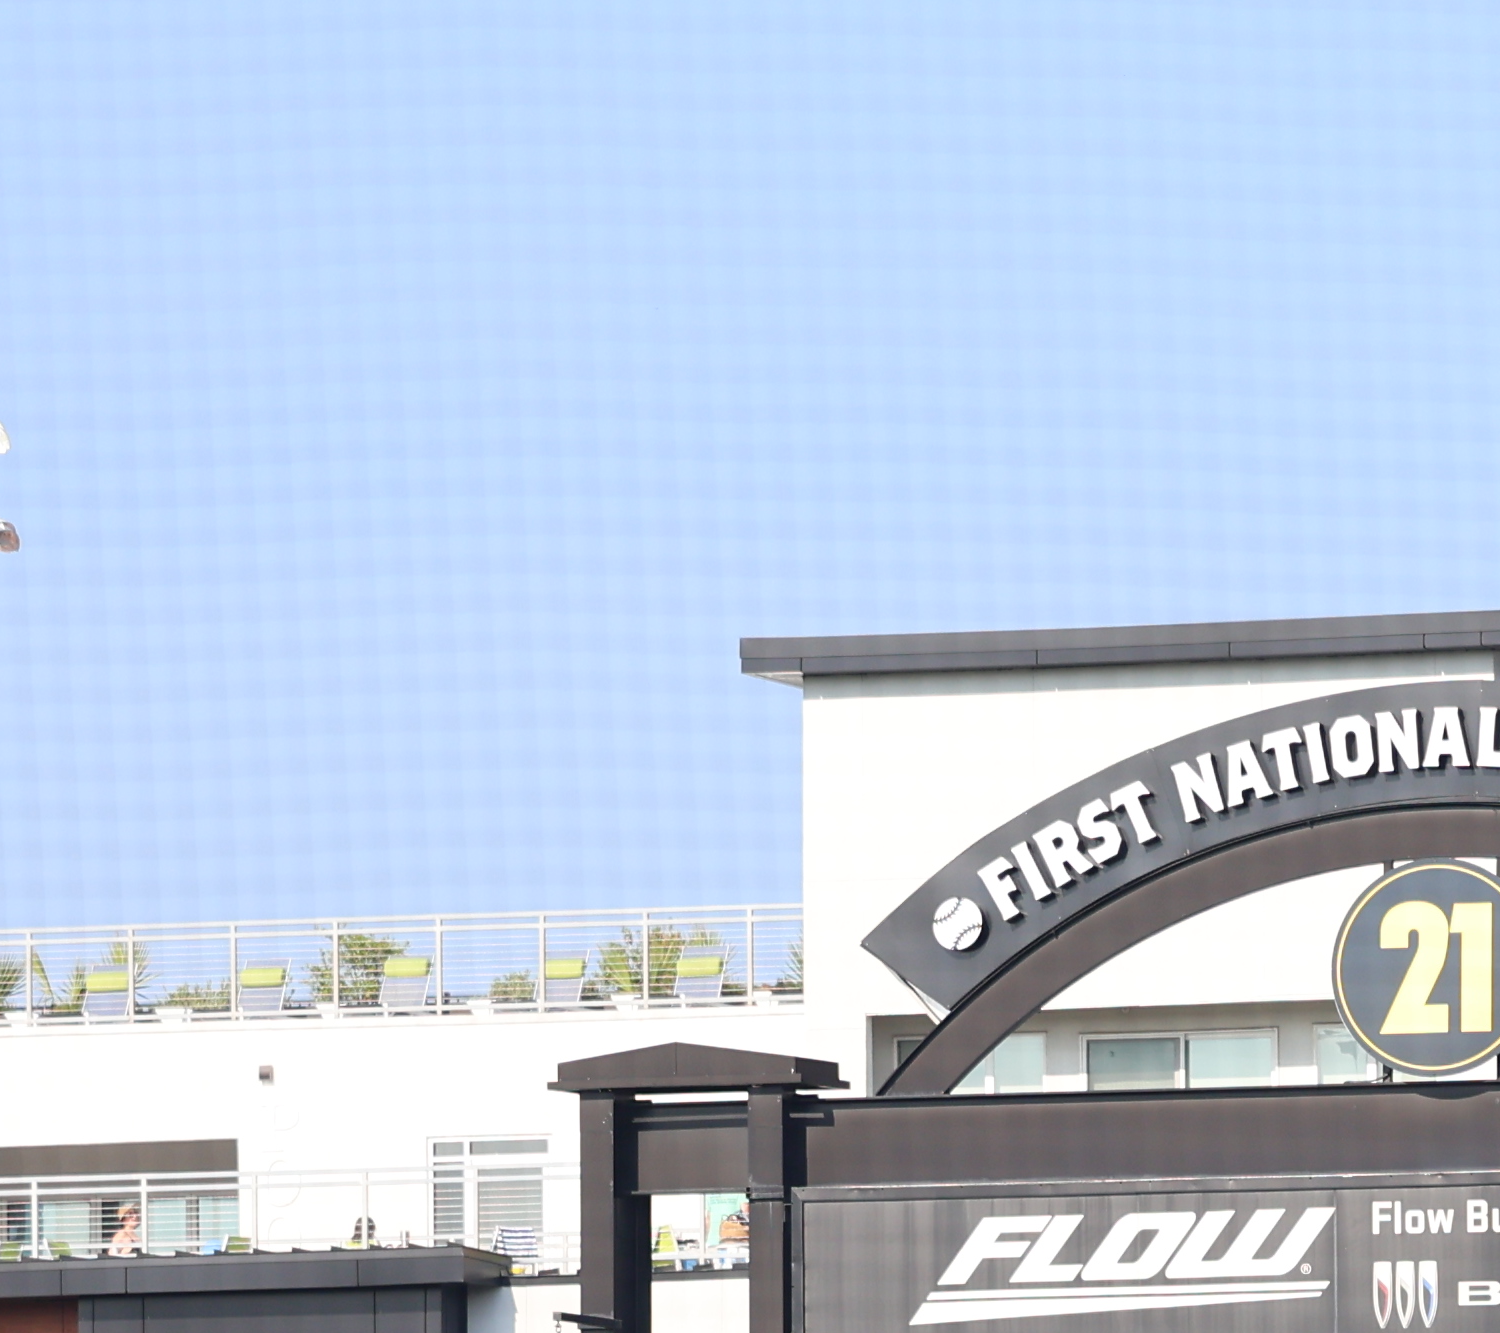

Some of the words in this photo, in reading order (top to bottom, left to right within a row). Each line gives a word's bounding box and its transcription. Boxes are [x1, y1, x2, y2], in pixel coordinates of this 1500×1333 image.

[978, 780, 1162, 921] FIRST
[1379, 900, 1493, 1034] 21
[937, 1207, 1337, 1286] FLOW
[1372, 1201, 1454, 1235] Flow
